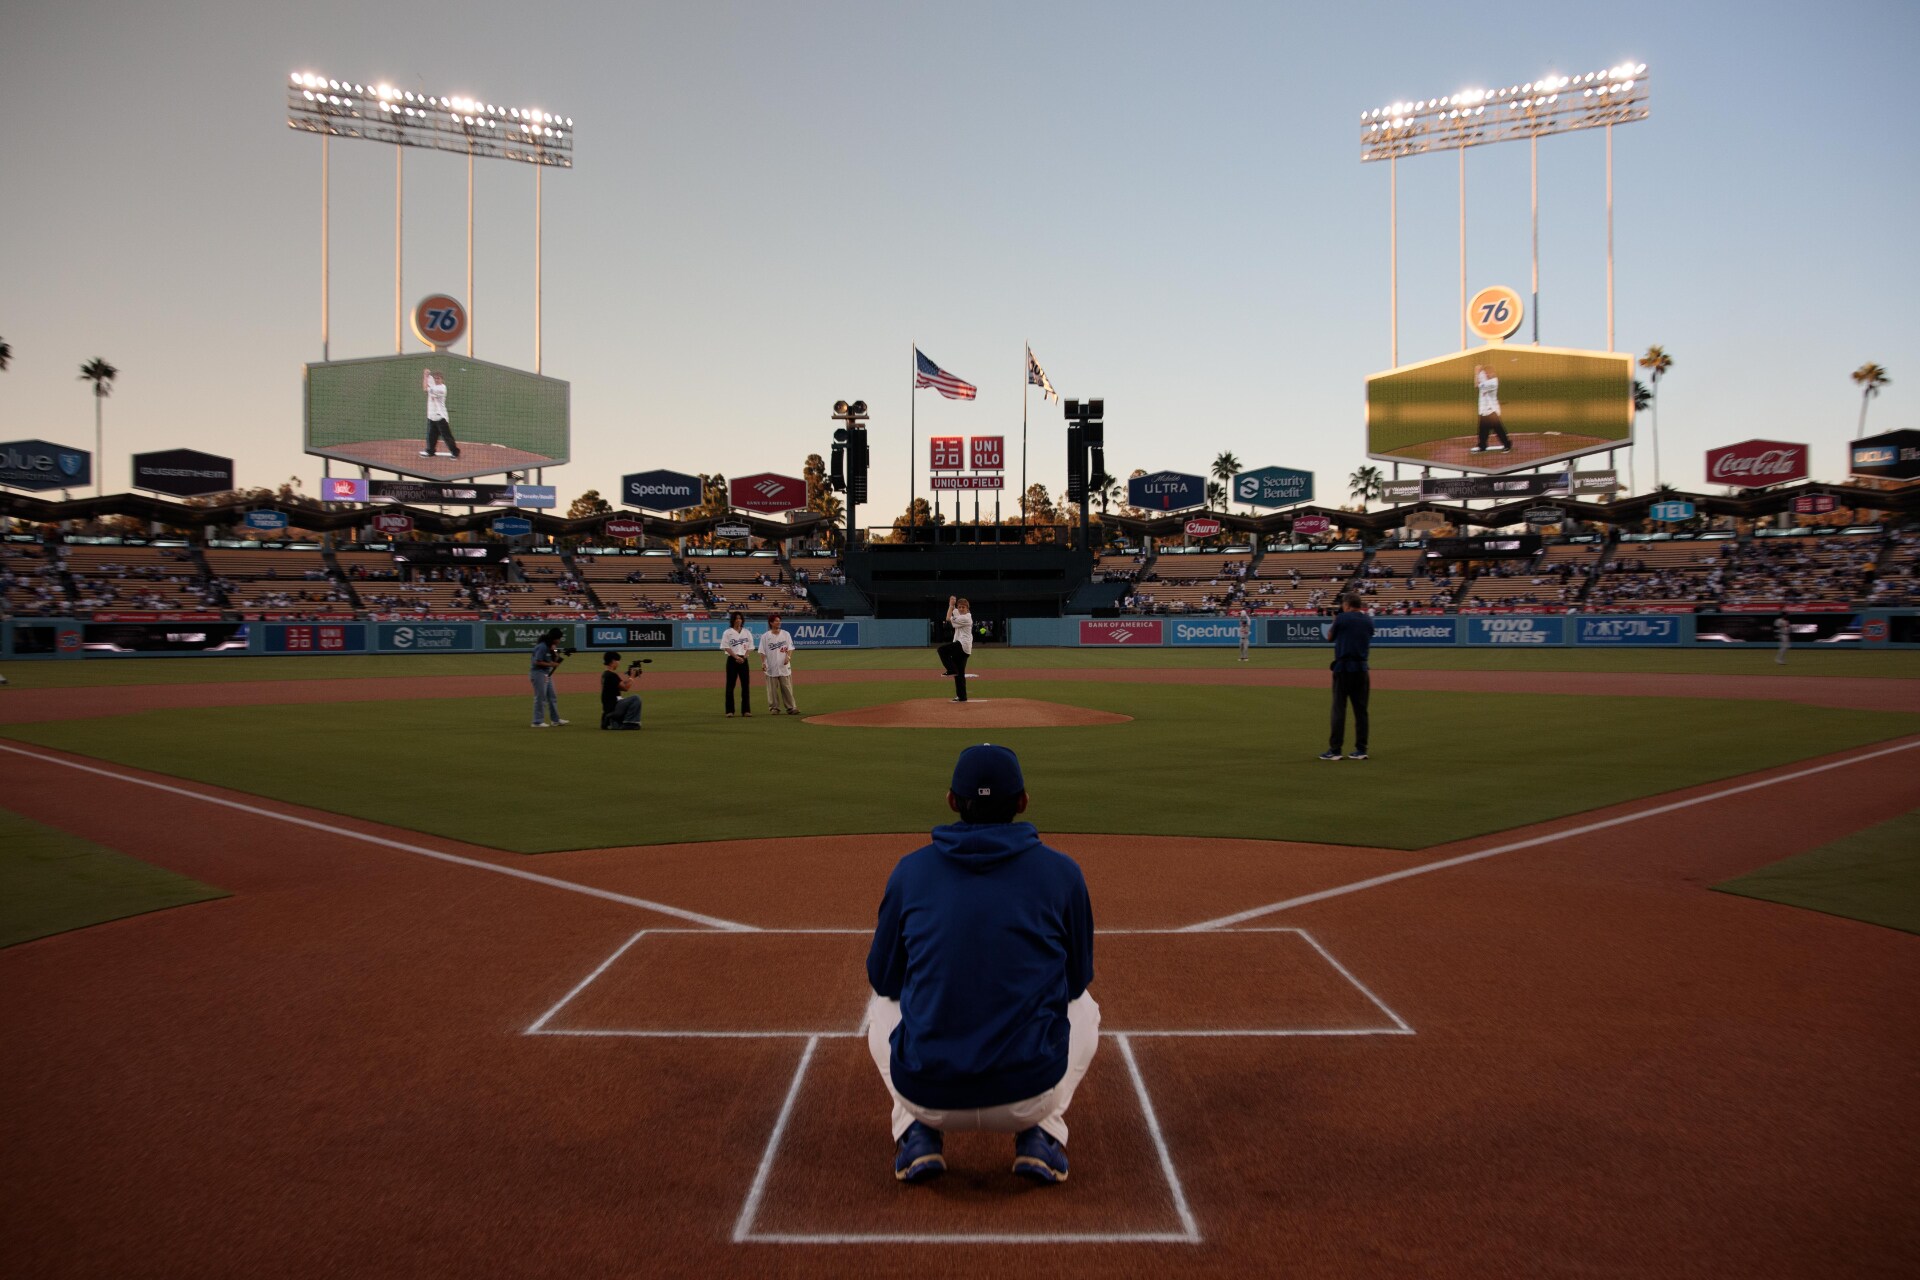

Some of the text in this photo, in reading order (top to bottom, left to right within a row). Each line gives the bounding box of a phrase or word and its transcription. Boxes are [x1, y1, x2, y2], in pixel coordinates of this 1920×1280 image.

[1479, 299, 1510, 324] 76
[427, 308, 457, 332] 76
[974, 440, 998, 452] UNI
[974, 453, 1000, 467] QLO
[934, 478, 1001, 489] UNIQLO FIELD
[1263, 475, 1307, 488] Security
[631, 482, 690, 497] Spectrum
[1144, 483, 1188, 494] ULTRA
[1263, 487, 1300, 499] Benefit
[1654, 504, 1690, 518] TEL
[380, 517, 407, 528] JINRO
[1186, 523, 1218, 533] Churu
[1287, 624, 1320, 636] blue
[1482, 619, 1533, 631] TOYO
[320, 628, 341, 637] UNI
[417, 627, 457, 638] Security
[598, 631, 623, 640] UCLA
[629, 631, 666, 641] Health
[684, 626, 723, 644] TEL
[794, 625, 825, 638] ANA
[1372, 626, 1452, 638] smartwater
[1489, 631, 1546, 643] TIRES
[320, 638, 343, 648] QLO
[417, 638, 452, 647] Benefit
